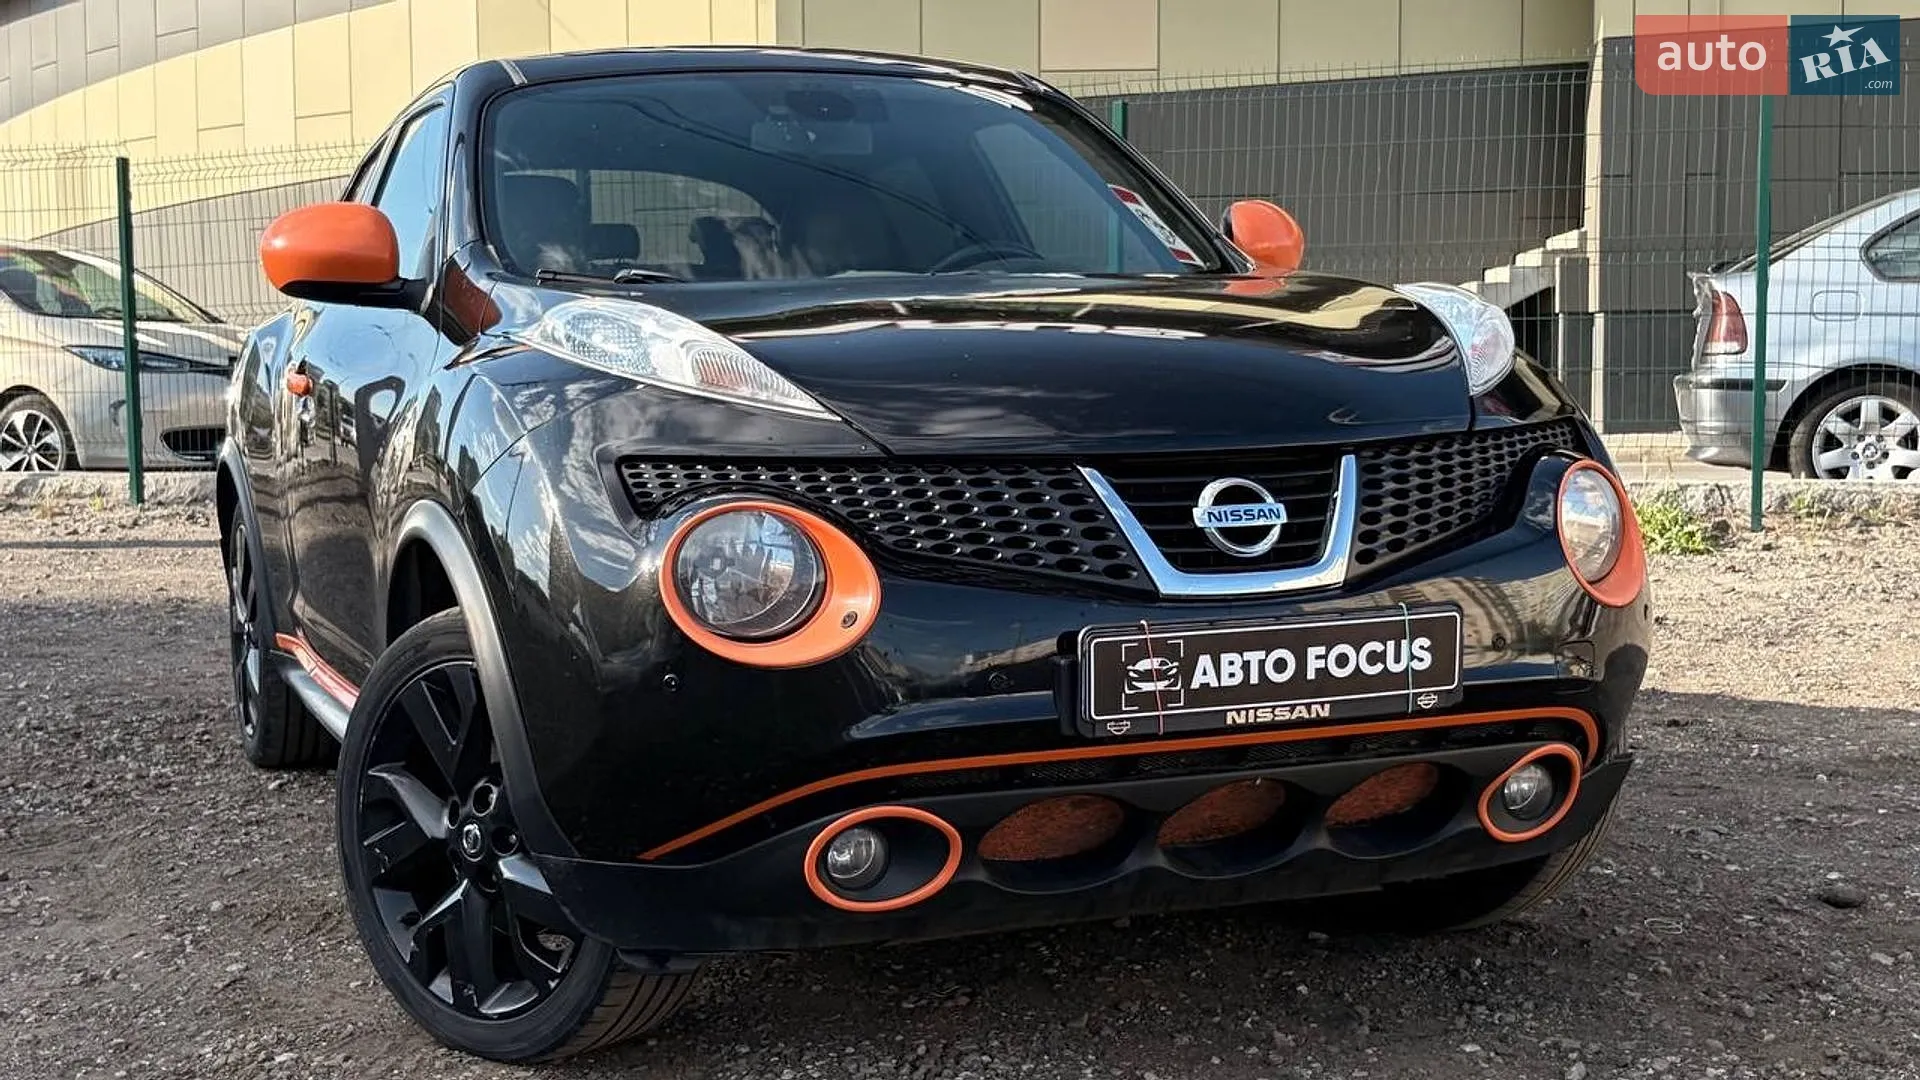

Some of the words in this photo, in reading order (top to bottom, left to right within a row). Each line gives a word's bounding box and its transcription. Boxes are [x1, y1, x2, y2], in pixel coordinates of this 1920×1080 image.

[1207, 508, 1281, 523] NISSAN
[1191, 648, 1296, 689] АВТО
[1306, 637, 1432, 680] FOCUS
[1226, 703, 1330, 725] NISSAN
